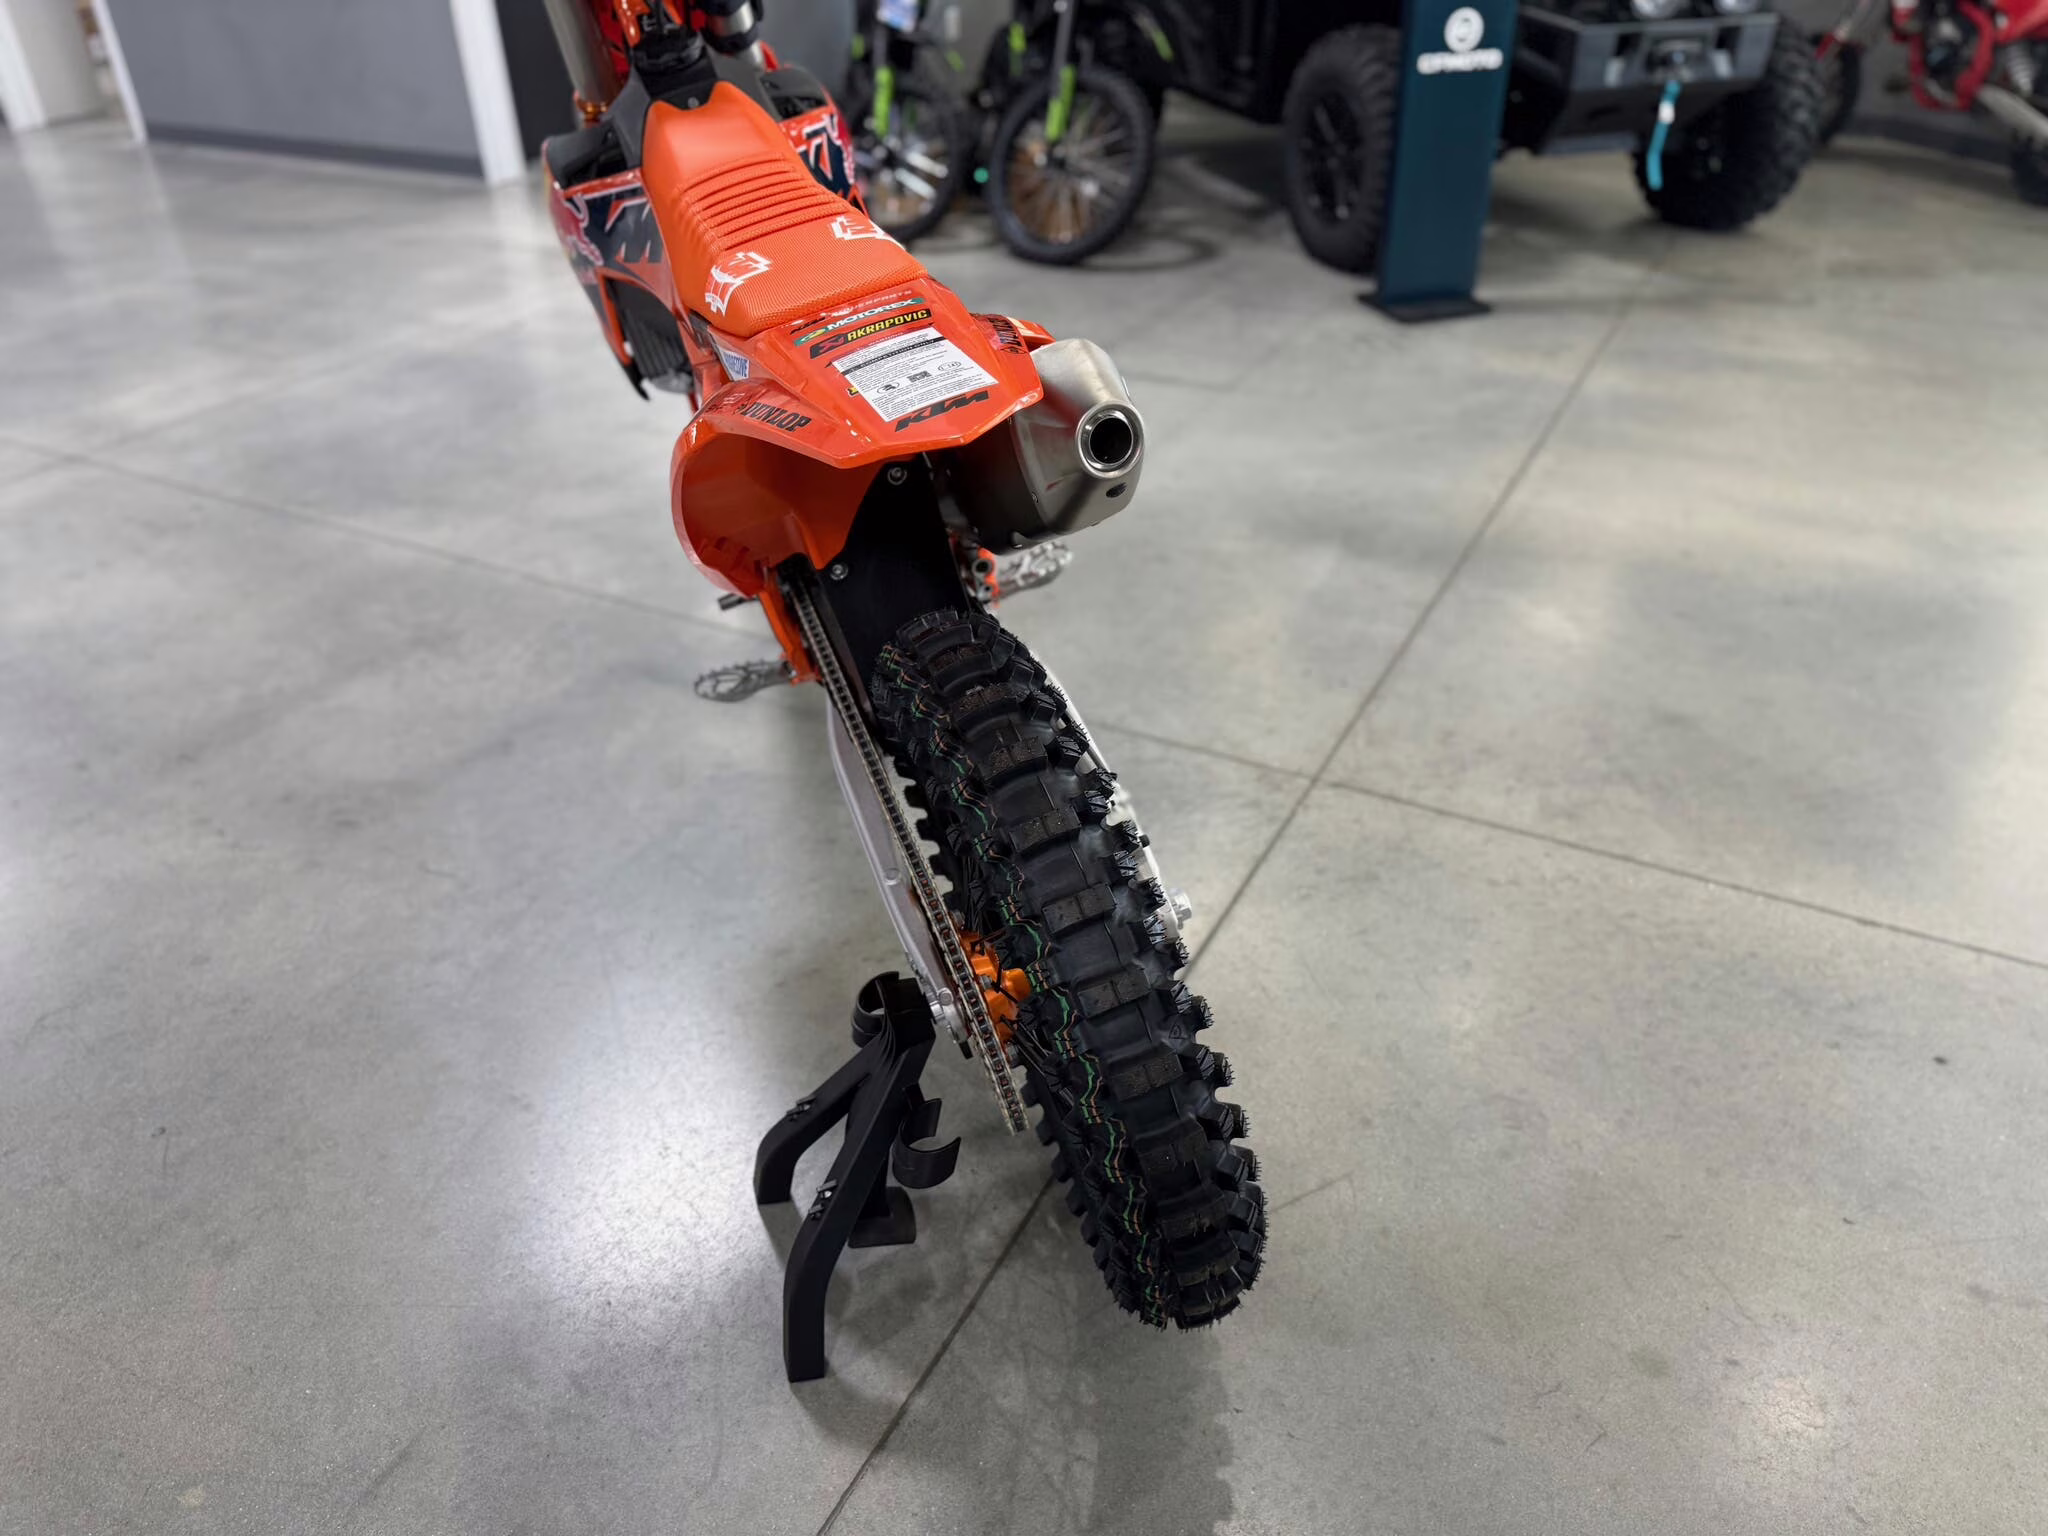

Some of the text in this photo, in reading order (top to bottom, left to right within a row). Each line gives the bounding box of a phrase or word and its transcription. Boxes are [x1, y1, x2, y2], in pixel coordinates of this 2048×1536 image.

[827, 298, 917, 331] MOTOREX
[847, 310, 928, 342] AKRAPOVIC
[741, 401, 812, 432] DUNLOP
[895, 390, 989, 432] KTM
